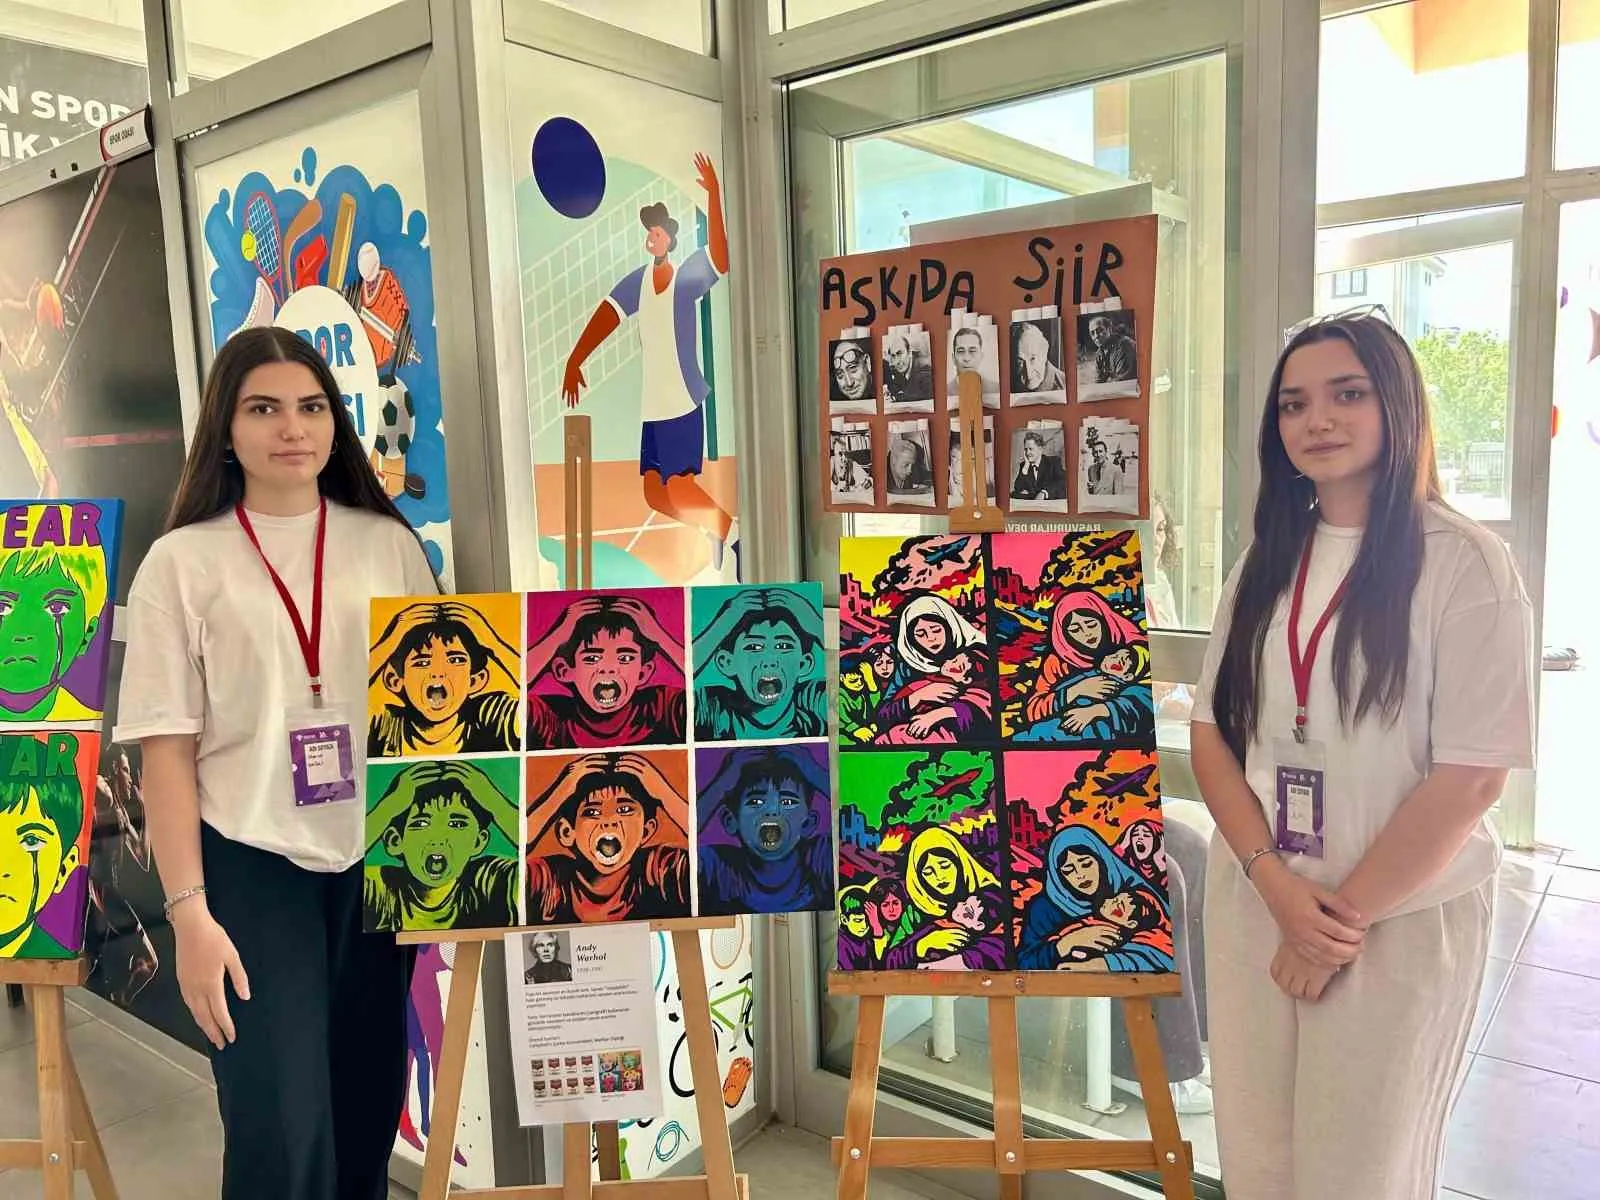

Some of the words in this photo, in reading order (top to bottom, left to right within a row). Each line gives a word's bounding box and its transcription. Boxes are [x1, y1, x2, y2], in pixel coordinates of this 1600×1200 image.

[822, 259, 974, 326] ASKIDA
[0, 732, 80, 777] AR
[576, 944, 597, 952] Andy
[577, 953, 606, 962] Warhol
